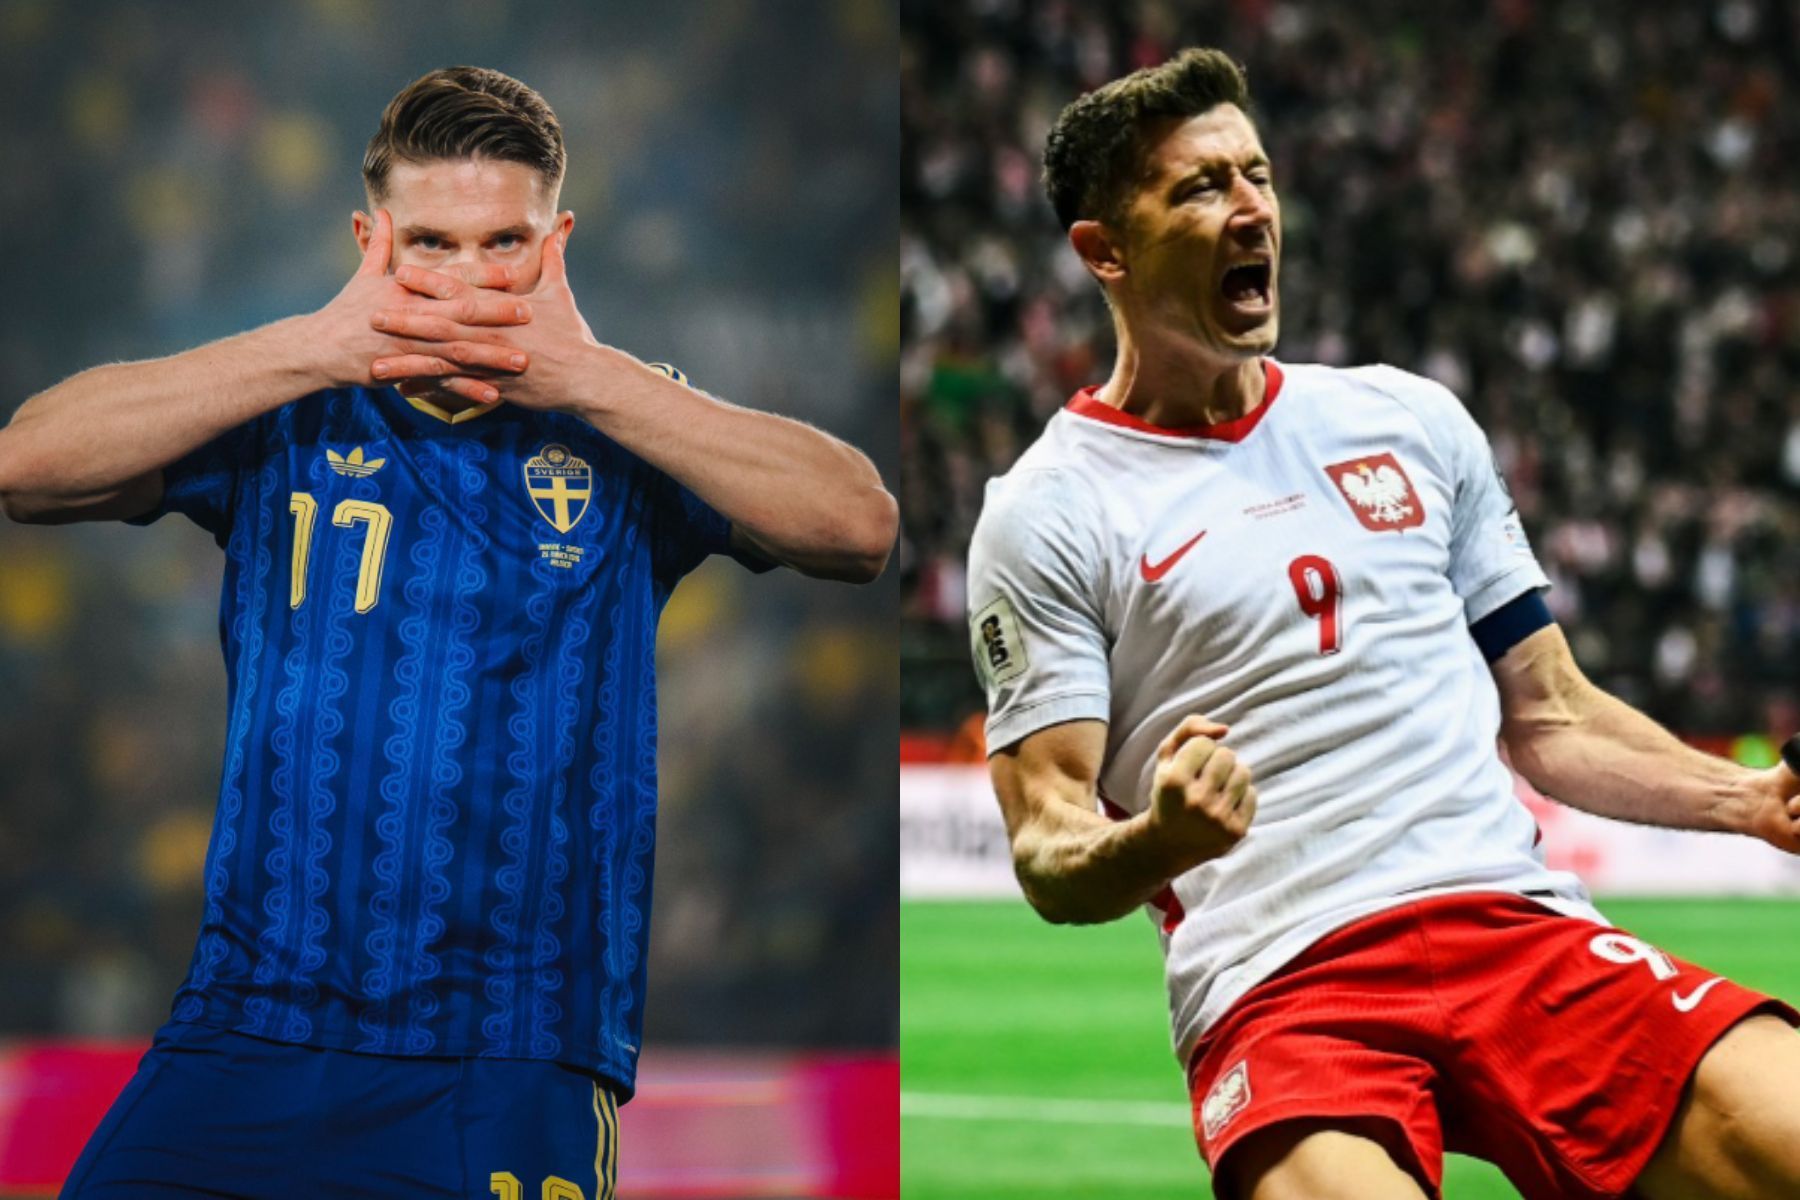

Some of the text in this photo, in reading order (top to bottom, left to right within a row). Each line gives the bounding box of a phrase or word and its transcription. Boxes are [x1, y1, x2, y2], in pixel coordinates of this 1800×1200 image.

[533, 467, 581, 477] SVERIGE
[289, 491, 393, 614] 17
[1287, 554, 1342, 656] 9
[1589, 933, 1679, 981] 9
